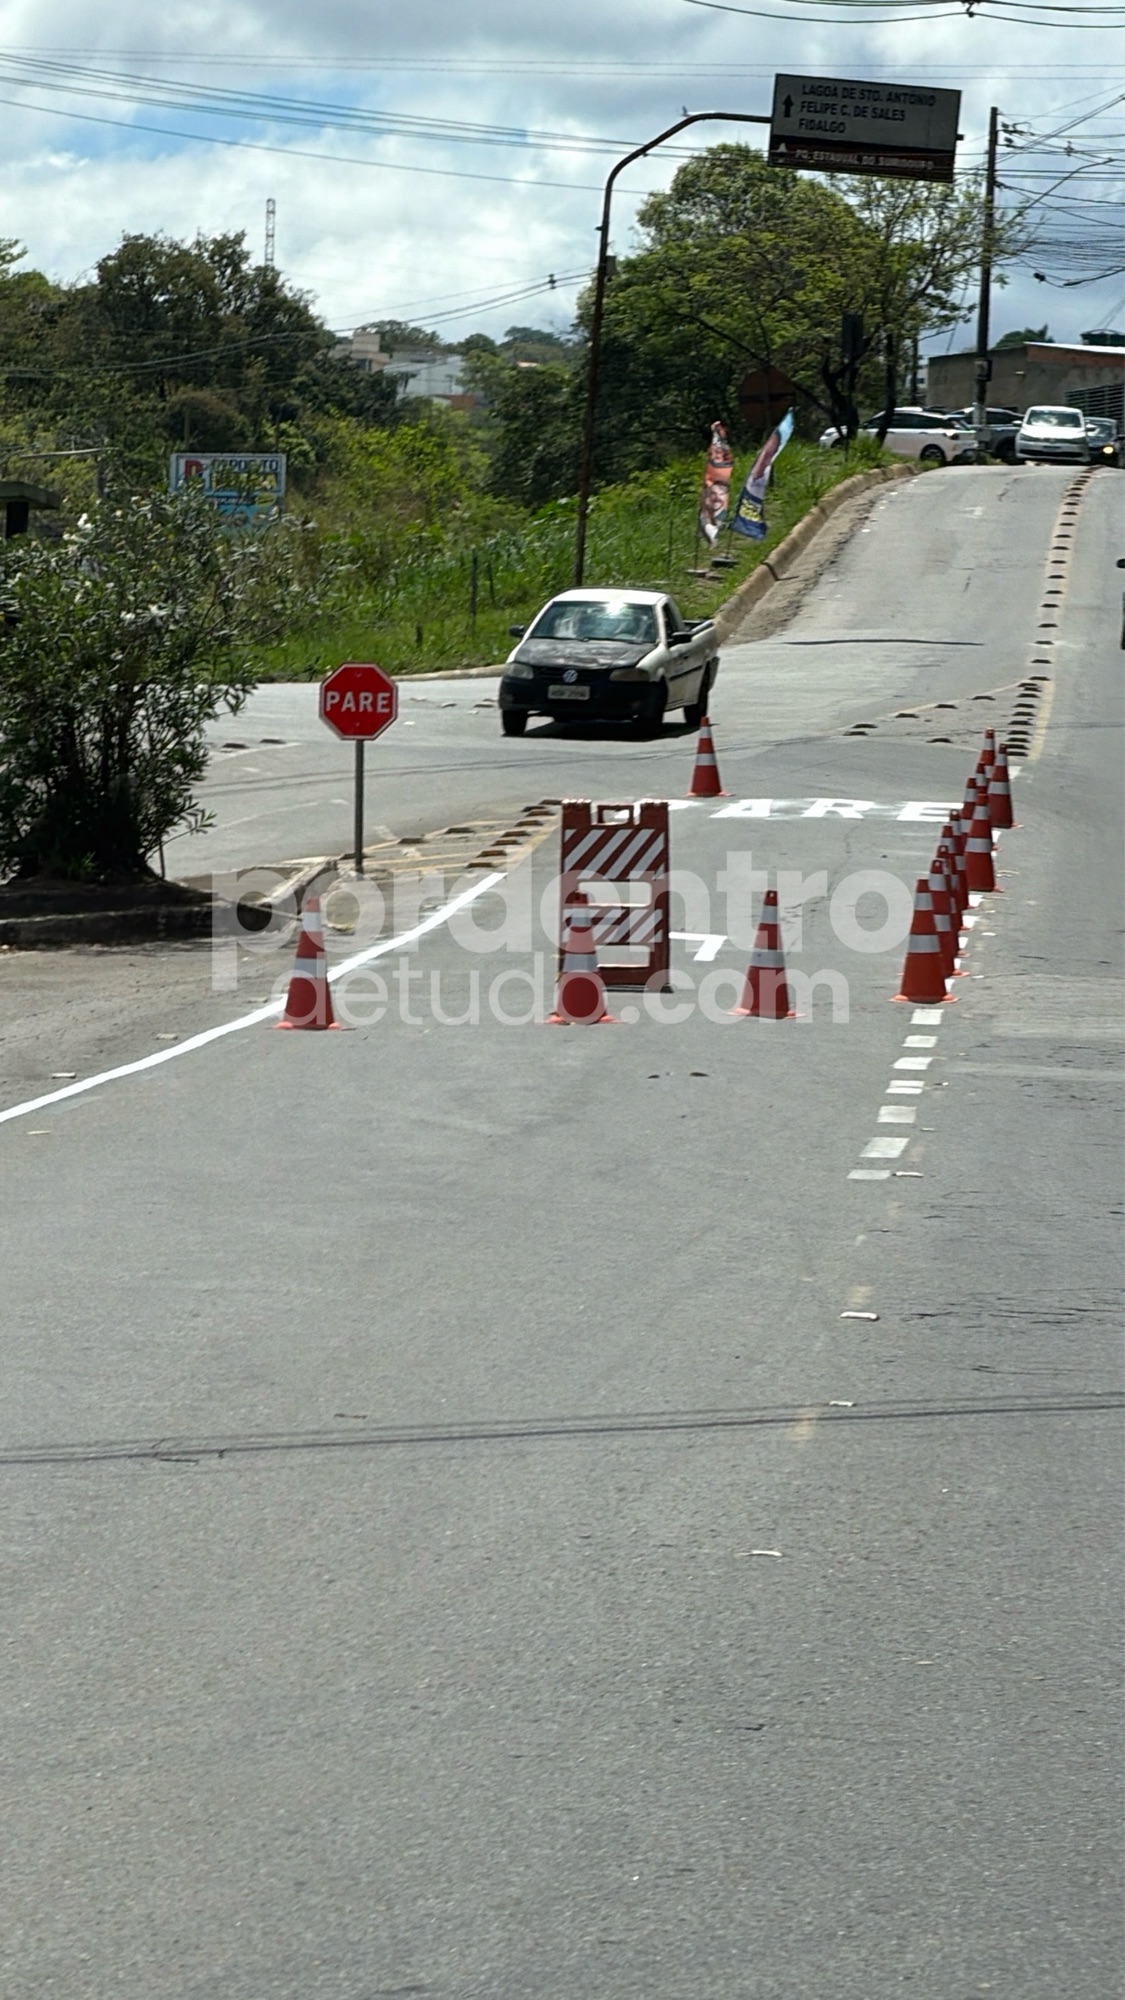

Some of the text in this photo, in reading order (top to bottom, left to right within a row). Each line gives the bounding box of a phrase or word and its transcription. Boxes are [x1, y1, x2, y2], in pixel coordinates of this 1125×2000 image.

[802, 84, 837, 97] LAGOA
[842, 87, 855, 99] DE
[800, 100, 837, 115] FELIPE
[853, 105, 868, 118] DE
[871, 107, 906, 121] SALES
[798, 117, 846, 133] FIDALGO
[325, 690, 391, 713] PARE
